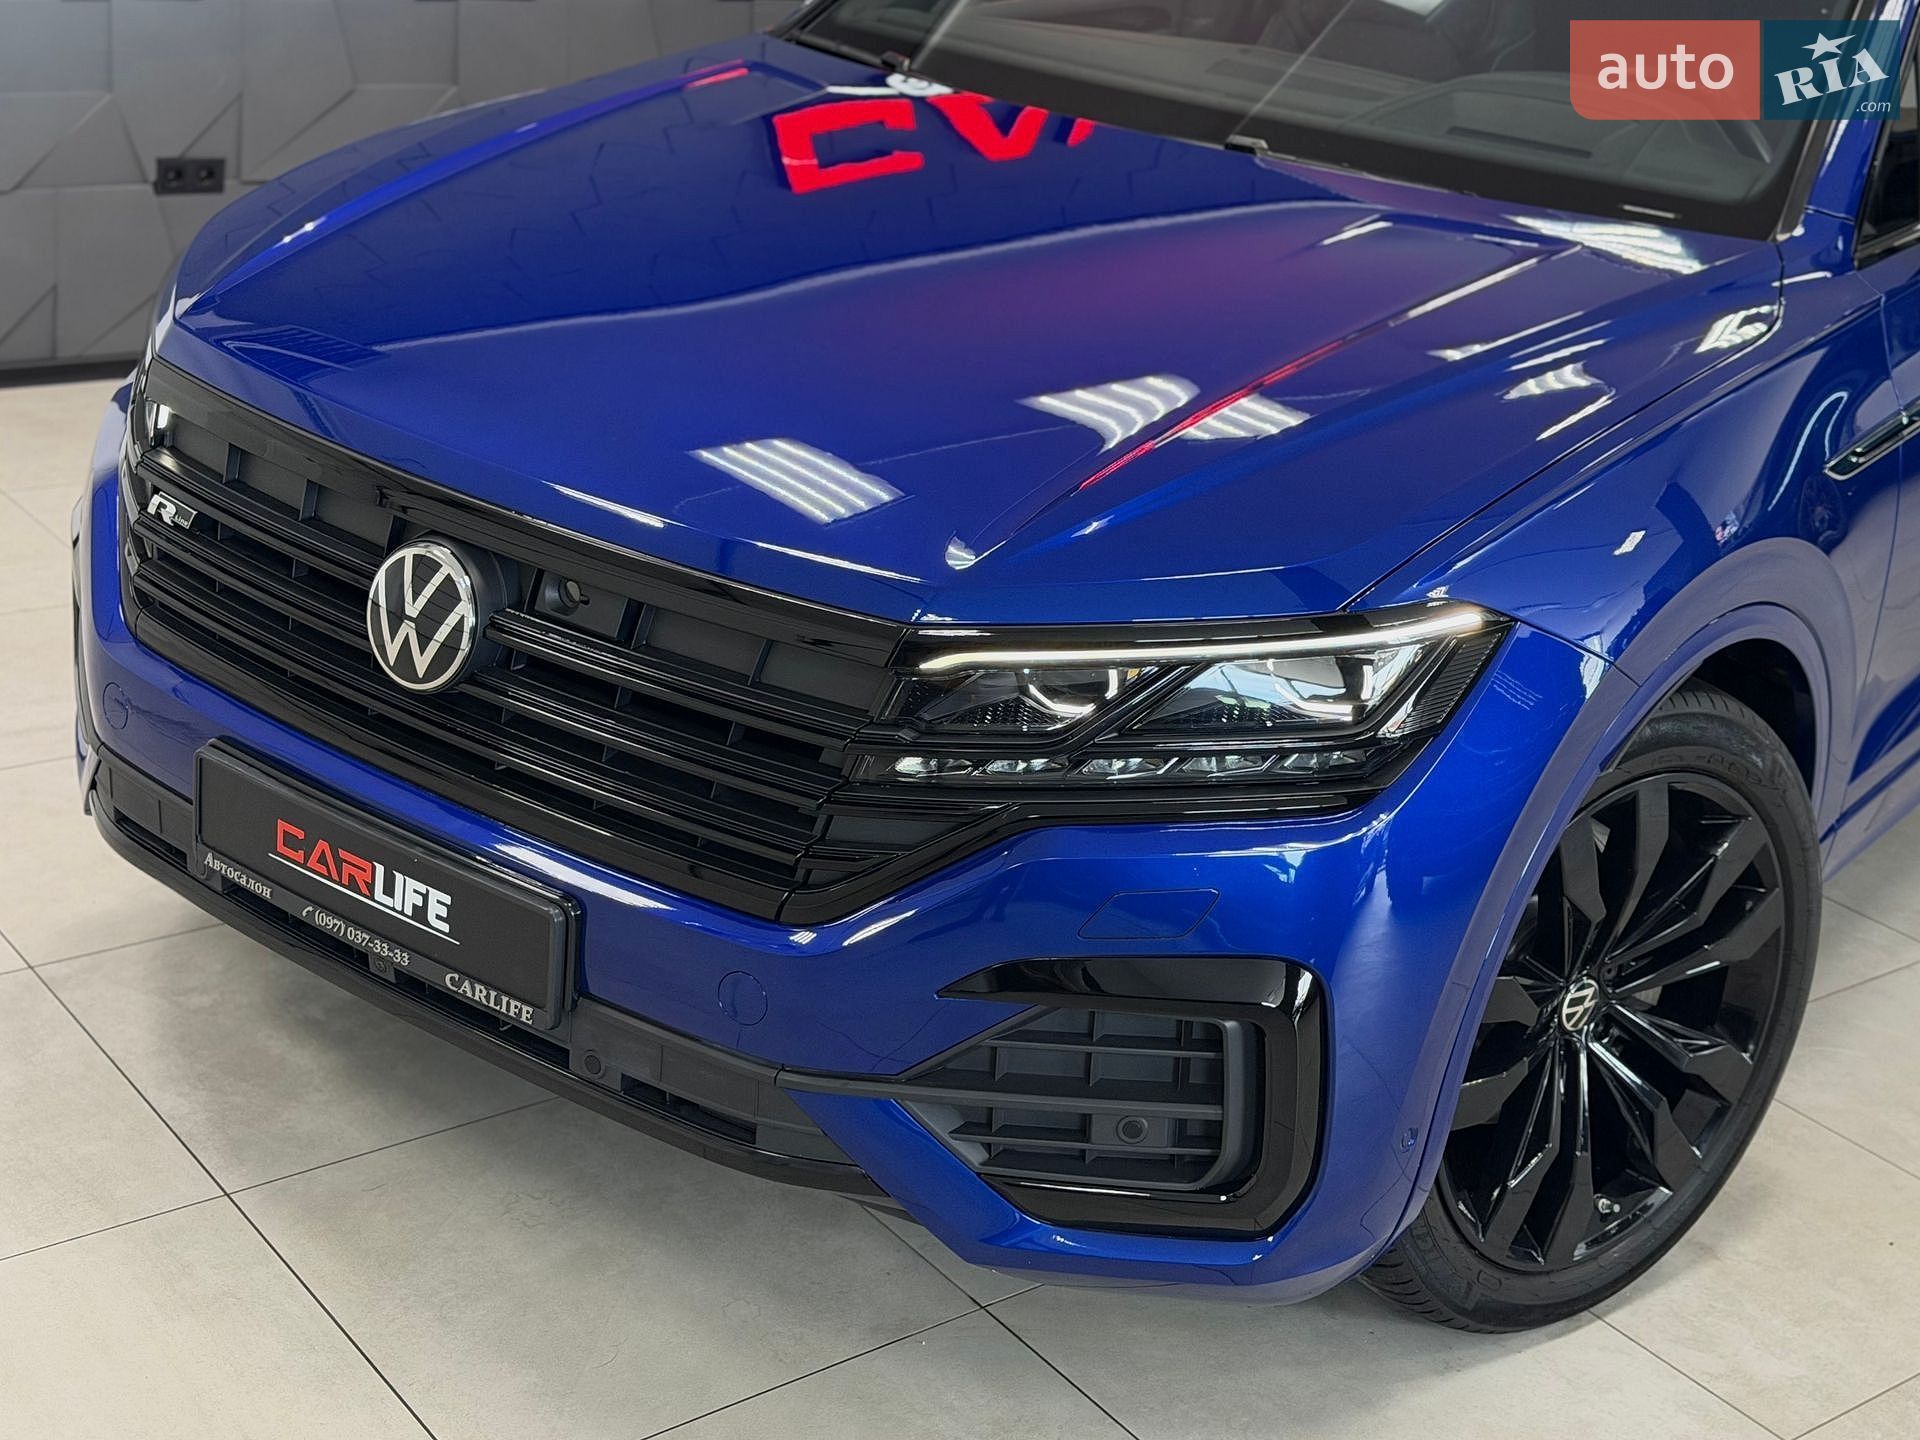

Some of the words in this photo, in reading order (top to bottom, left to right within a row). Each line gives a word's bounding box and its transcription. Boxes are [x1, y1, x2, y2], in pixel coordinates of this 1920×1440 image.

[374, 546, 472, 685] VW
[204, 852, 273, 899] Автосалон
[276, 818, 452, 934] CARLIFE
[314, 904, 346, 937] (097)
[346, 926, 410, 966] 037-33-33
[445, 973, 534, 1025] CARLIFE
